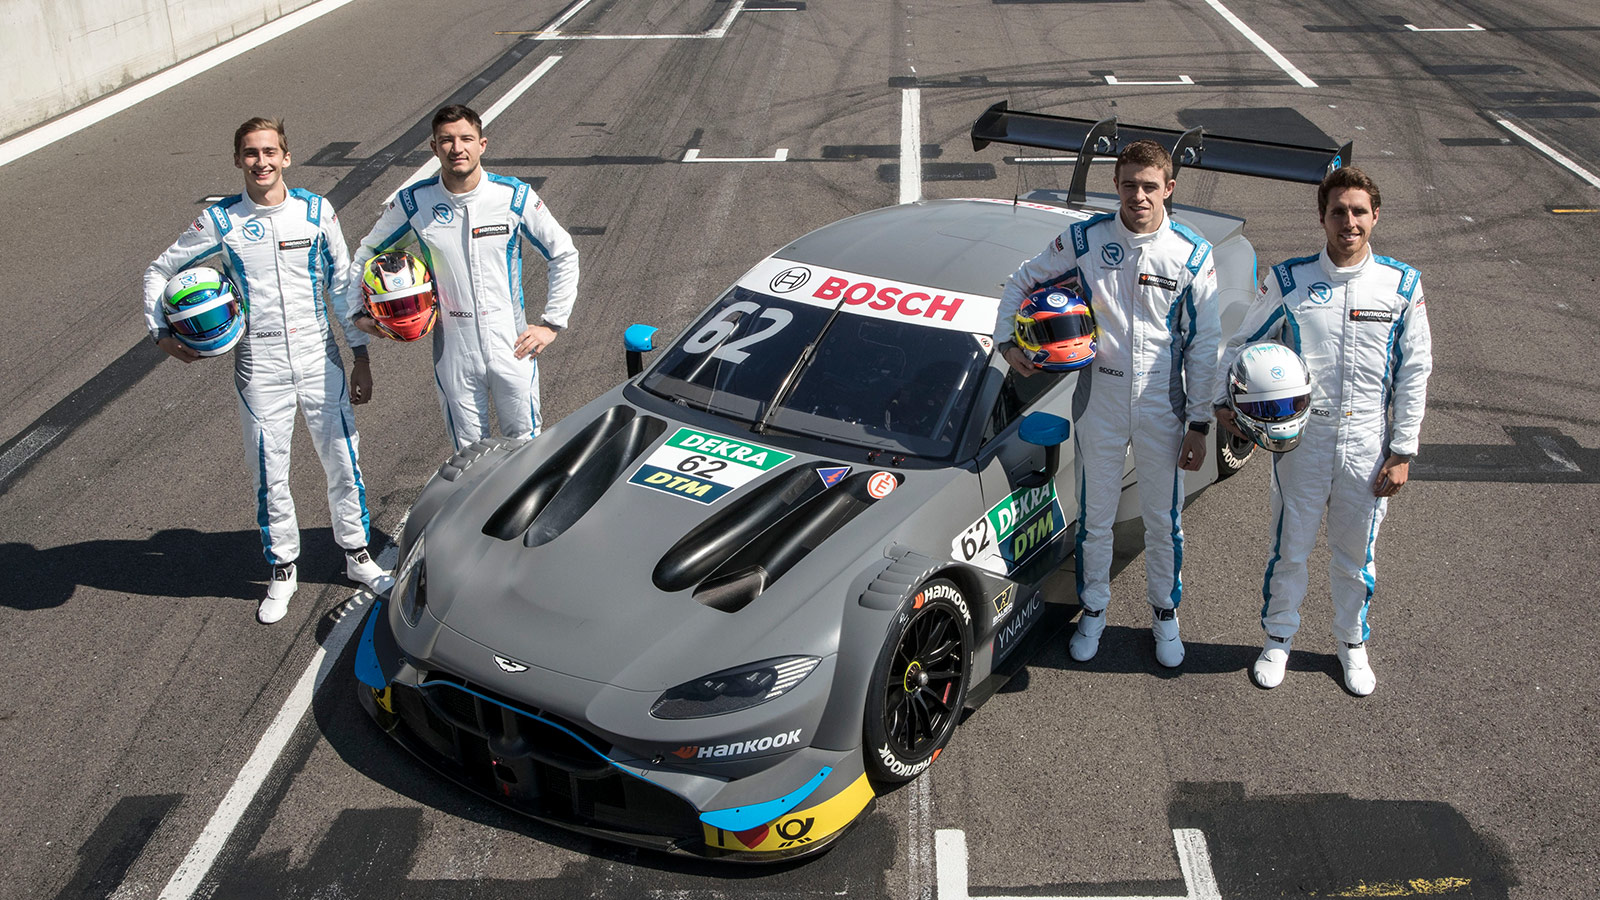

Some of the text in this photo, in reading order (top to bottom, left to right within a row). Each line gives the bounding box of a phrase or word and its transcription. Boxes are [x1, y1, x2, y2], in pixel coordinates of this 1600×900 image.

[402, 190, 414, 211] sparco
[1072, 224, 1083, 250] sparco
[1277, 264, 1291, 287] sparco
[813, 276, 965, 322] BOSCH
[449, 310, 473, 318] sparco
[255, 330, 282, 338] sparco
[682, 301, 793, 365] 62
[1098, 366, 1124, 377] sparco
[1311, 407, 1330, 417] arco
[680, 434, 769, 467] DEKRA
[677, 455, 728, 480] 62
[644, 471, 713, 497] DTM
[998, 484, 1051, 535] DEKRA
[961, 519, 990, 561] 62
[1014, 511, 1054, 561] DTM
